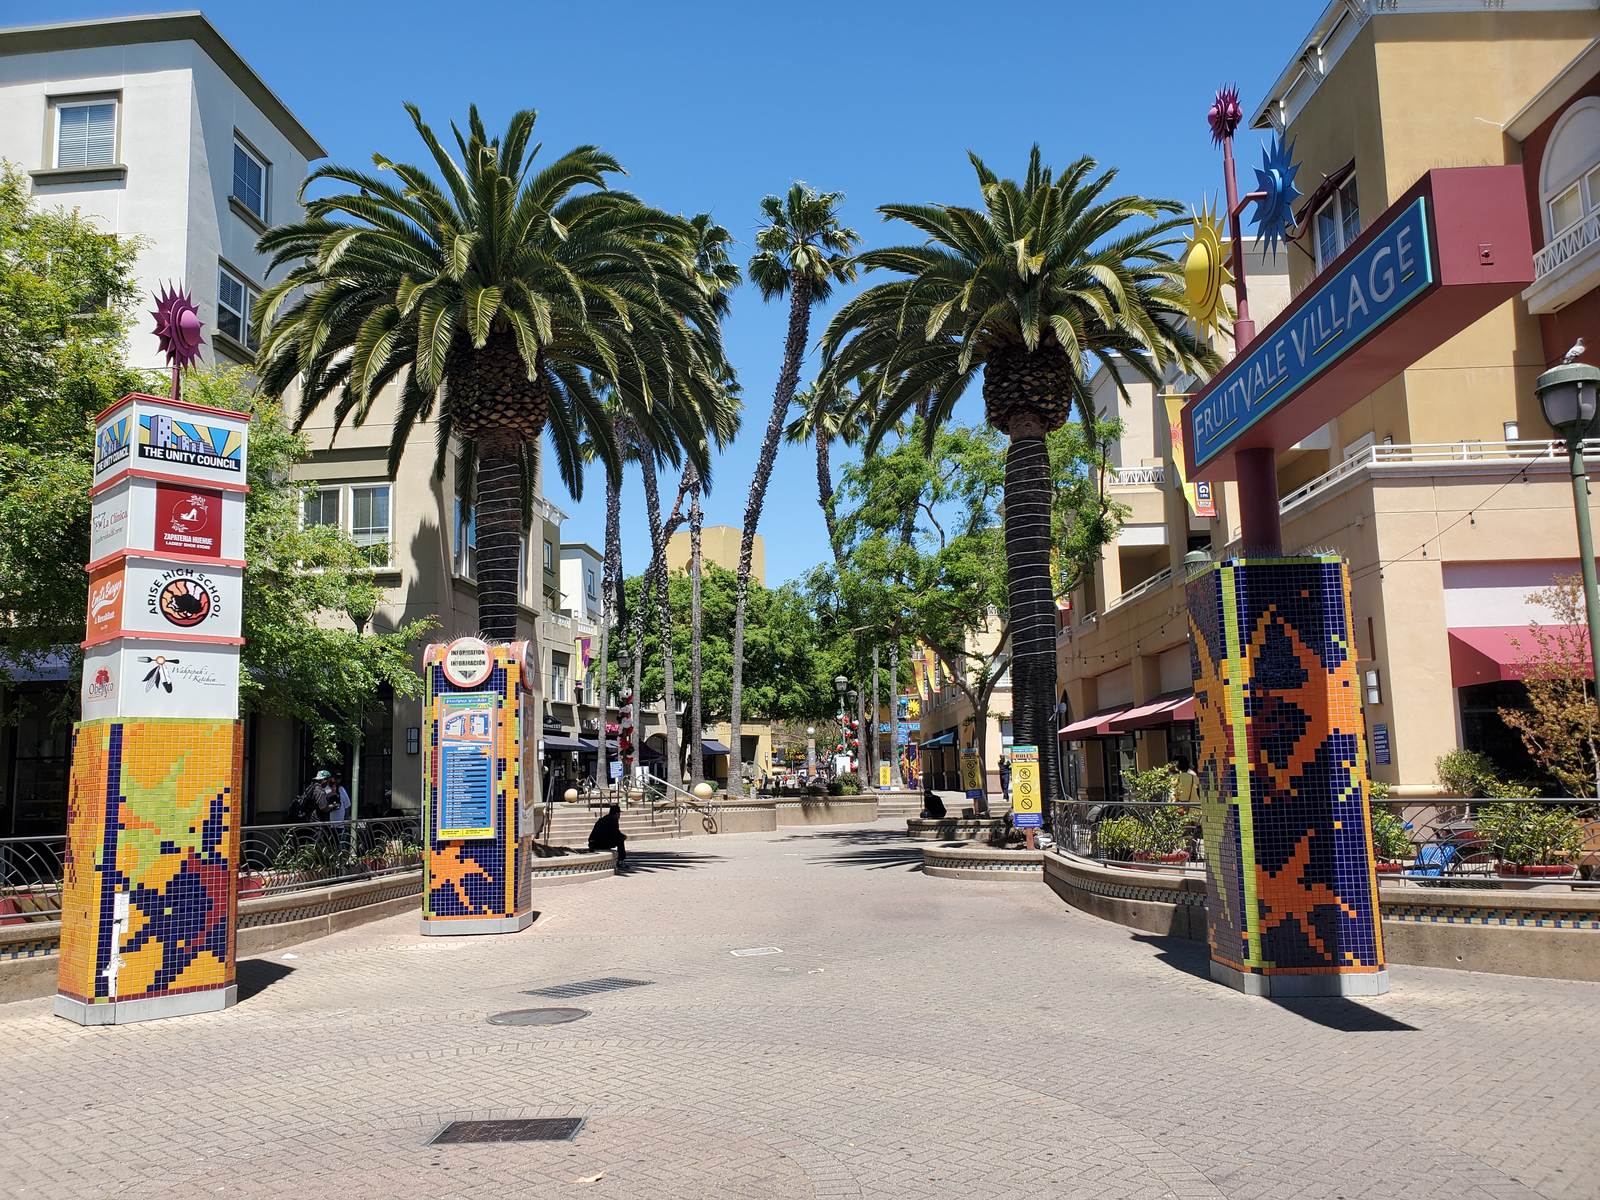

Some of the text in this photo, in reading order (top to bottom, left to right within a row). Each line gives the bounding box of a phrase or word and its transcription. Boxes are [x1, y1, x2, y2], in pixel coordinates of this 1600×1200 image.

[1193, 226, 1414, 453] FRUITVALE VILLAGE
[143, 446, 239, 471] THE UNITY COUNCIL
[147, 579, 163, 615] ARISE
[162, 568, 194, 581] HIGH
[196, 573, 221, 618] SCHOOL
